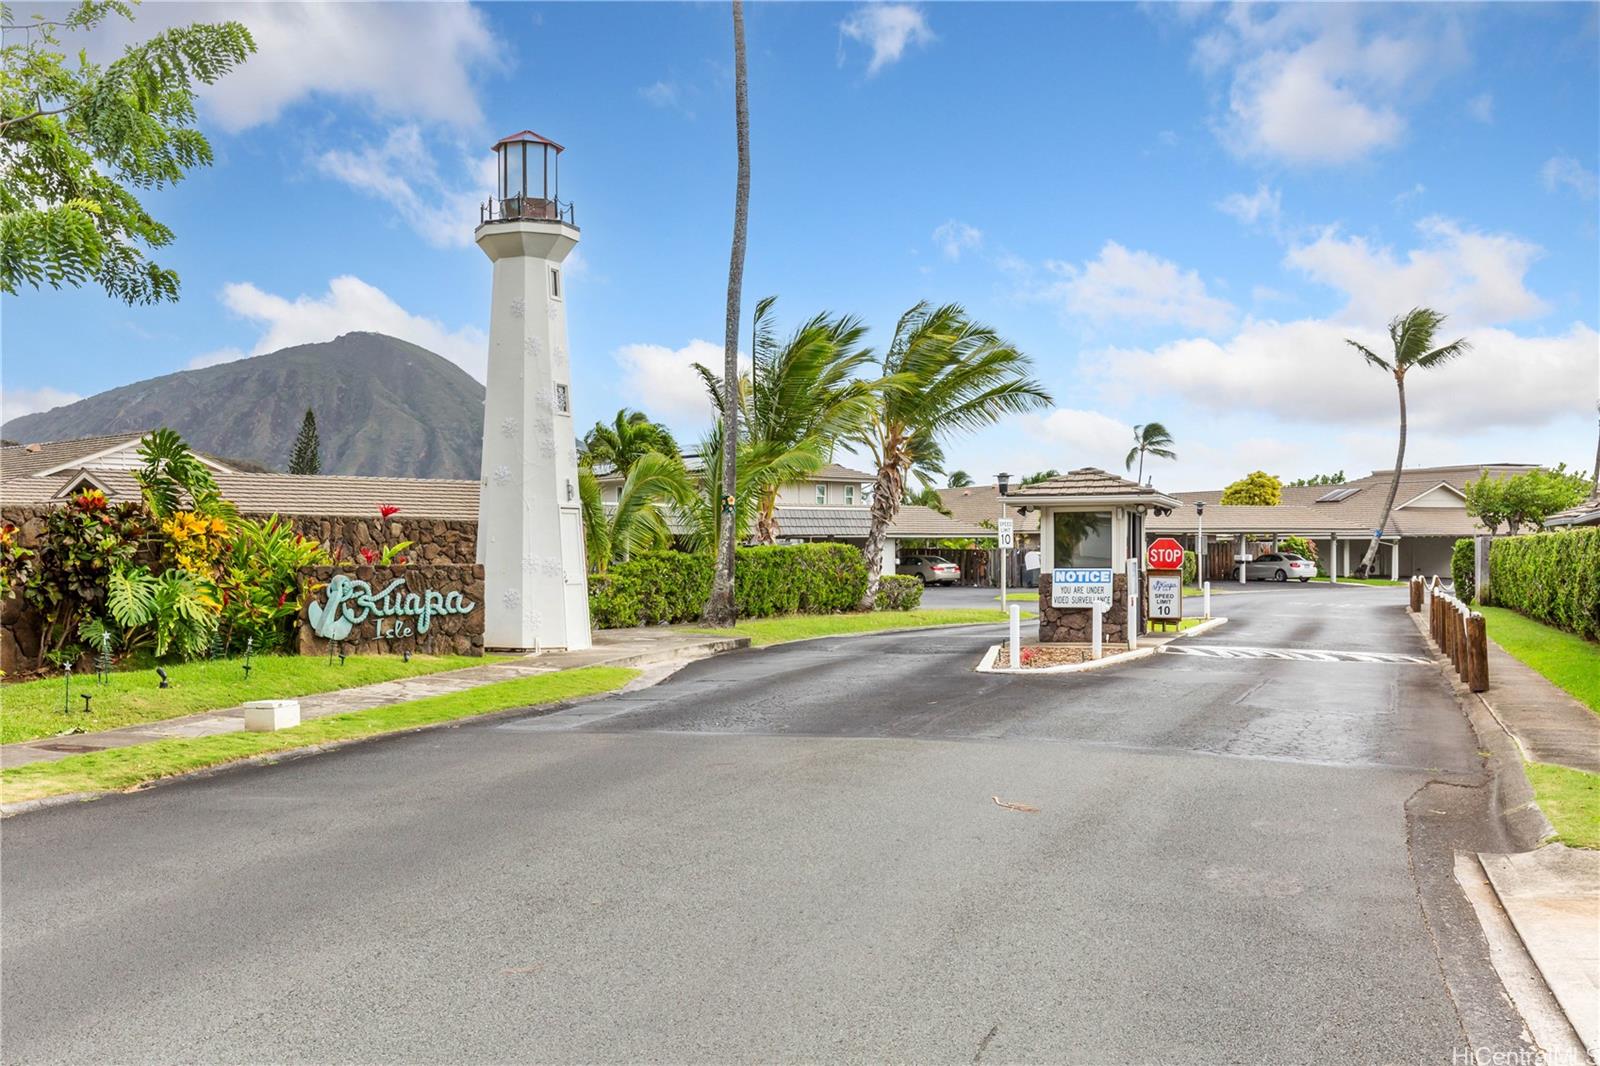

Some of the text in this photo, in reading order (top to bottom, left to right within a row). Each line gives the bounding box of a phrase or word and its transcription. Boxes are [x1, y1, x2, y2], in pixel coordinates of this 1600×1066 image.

[1001, 533, 1011, 544] 10
[1150, 549, 1181, 562] STOP
[1055, 571, 1110, 582] NOTICE
[1061, 585, 1105, 594] YOU ARE UNDER
[1053, 595, 1070, 604] VIDEO
[342, 577, 476, 634] Kuapa
[1157, 606, 1171, 615] 10
[372, 618, 415, 640] Isle
